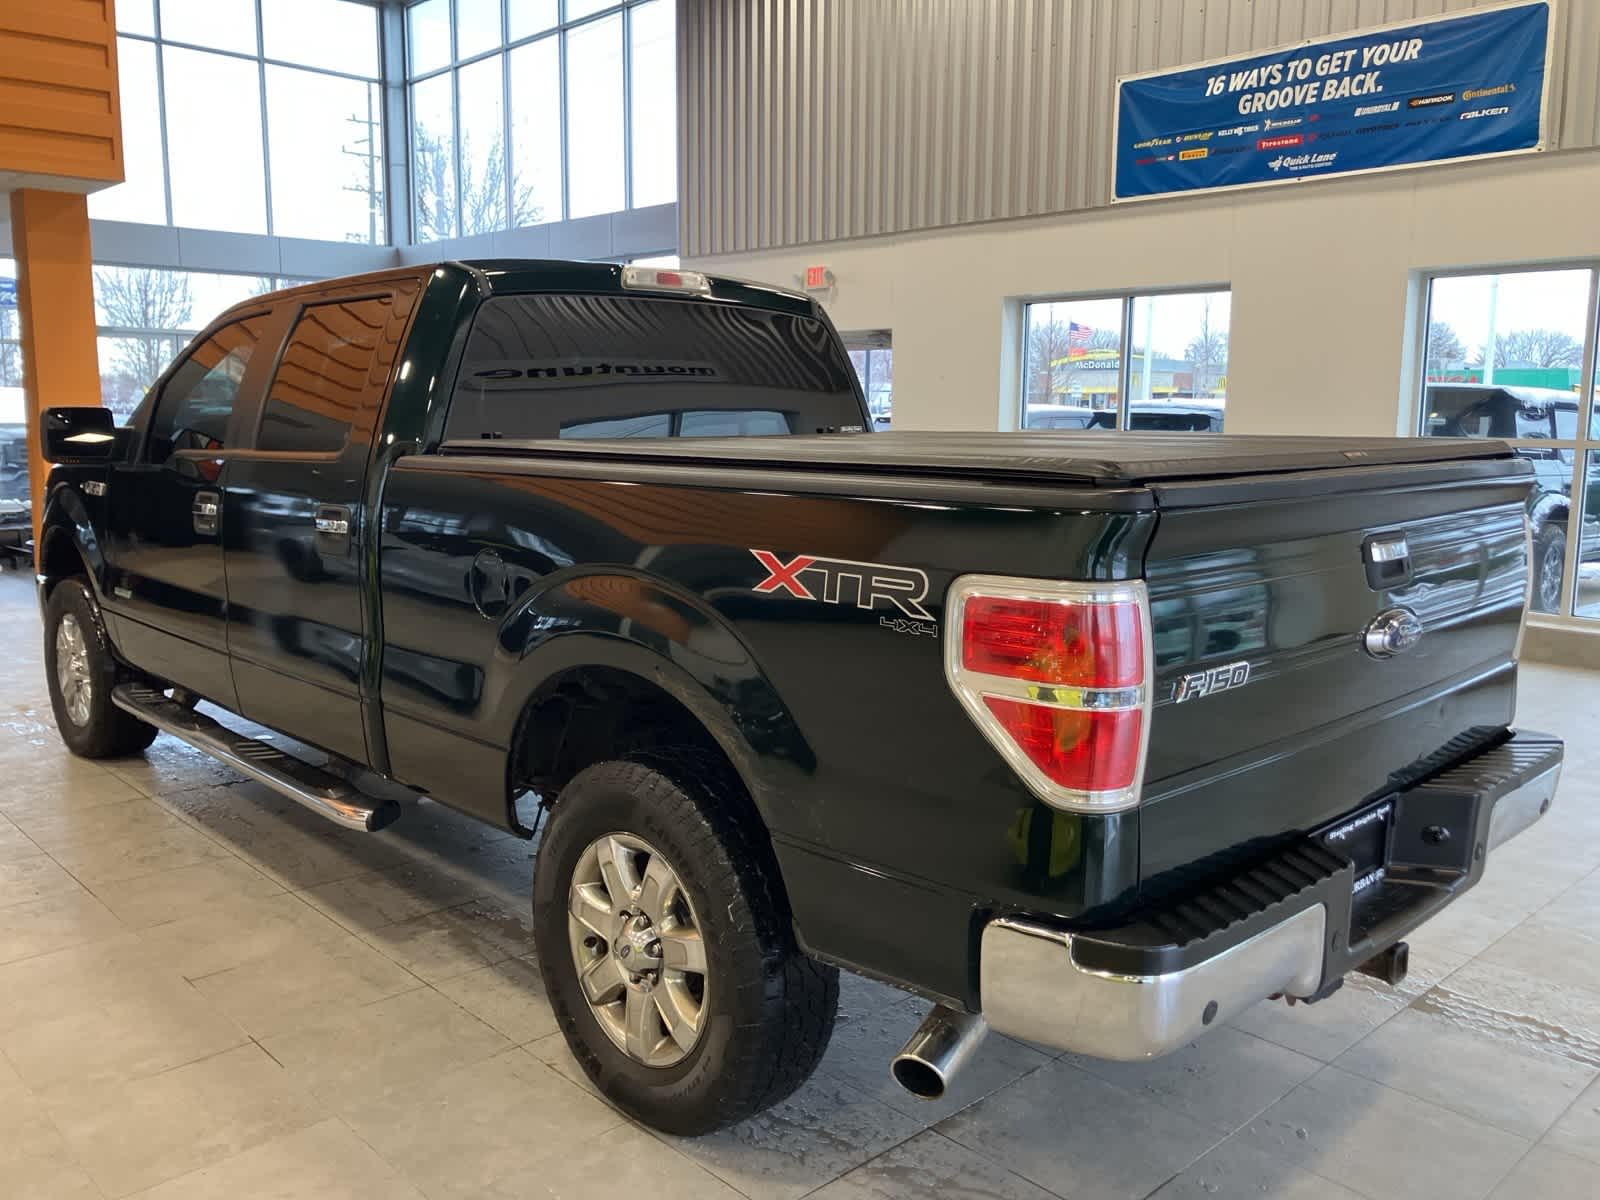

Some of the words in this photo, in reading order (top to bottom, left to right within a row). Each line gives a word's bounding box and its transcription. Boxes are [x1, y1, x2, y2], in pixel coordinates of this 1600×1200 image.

[1205, 75, 1226, 97] 16
[1228, 63, 1284, 93] WAYS
[1286, 58, 1312, 82] TO
[1315, 48, 1358, 77] GET
[1362, 38, 1423, 69] YOUR
[1238, 82, 1320, 115] GROOVE
[1321, 71, 1384, 101] BACK.
[1282, 154, 1311, 168] Quick
[1310, 152, 1337, 163] Lane
[748, 547, 936, 622] XTR
